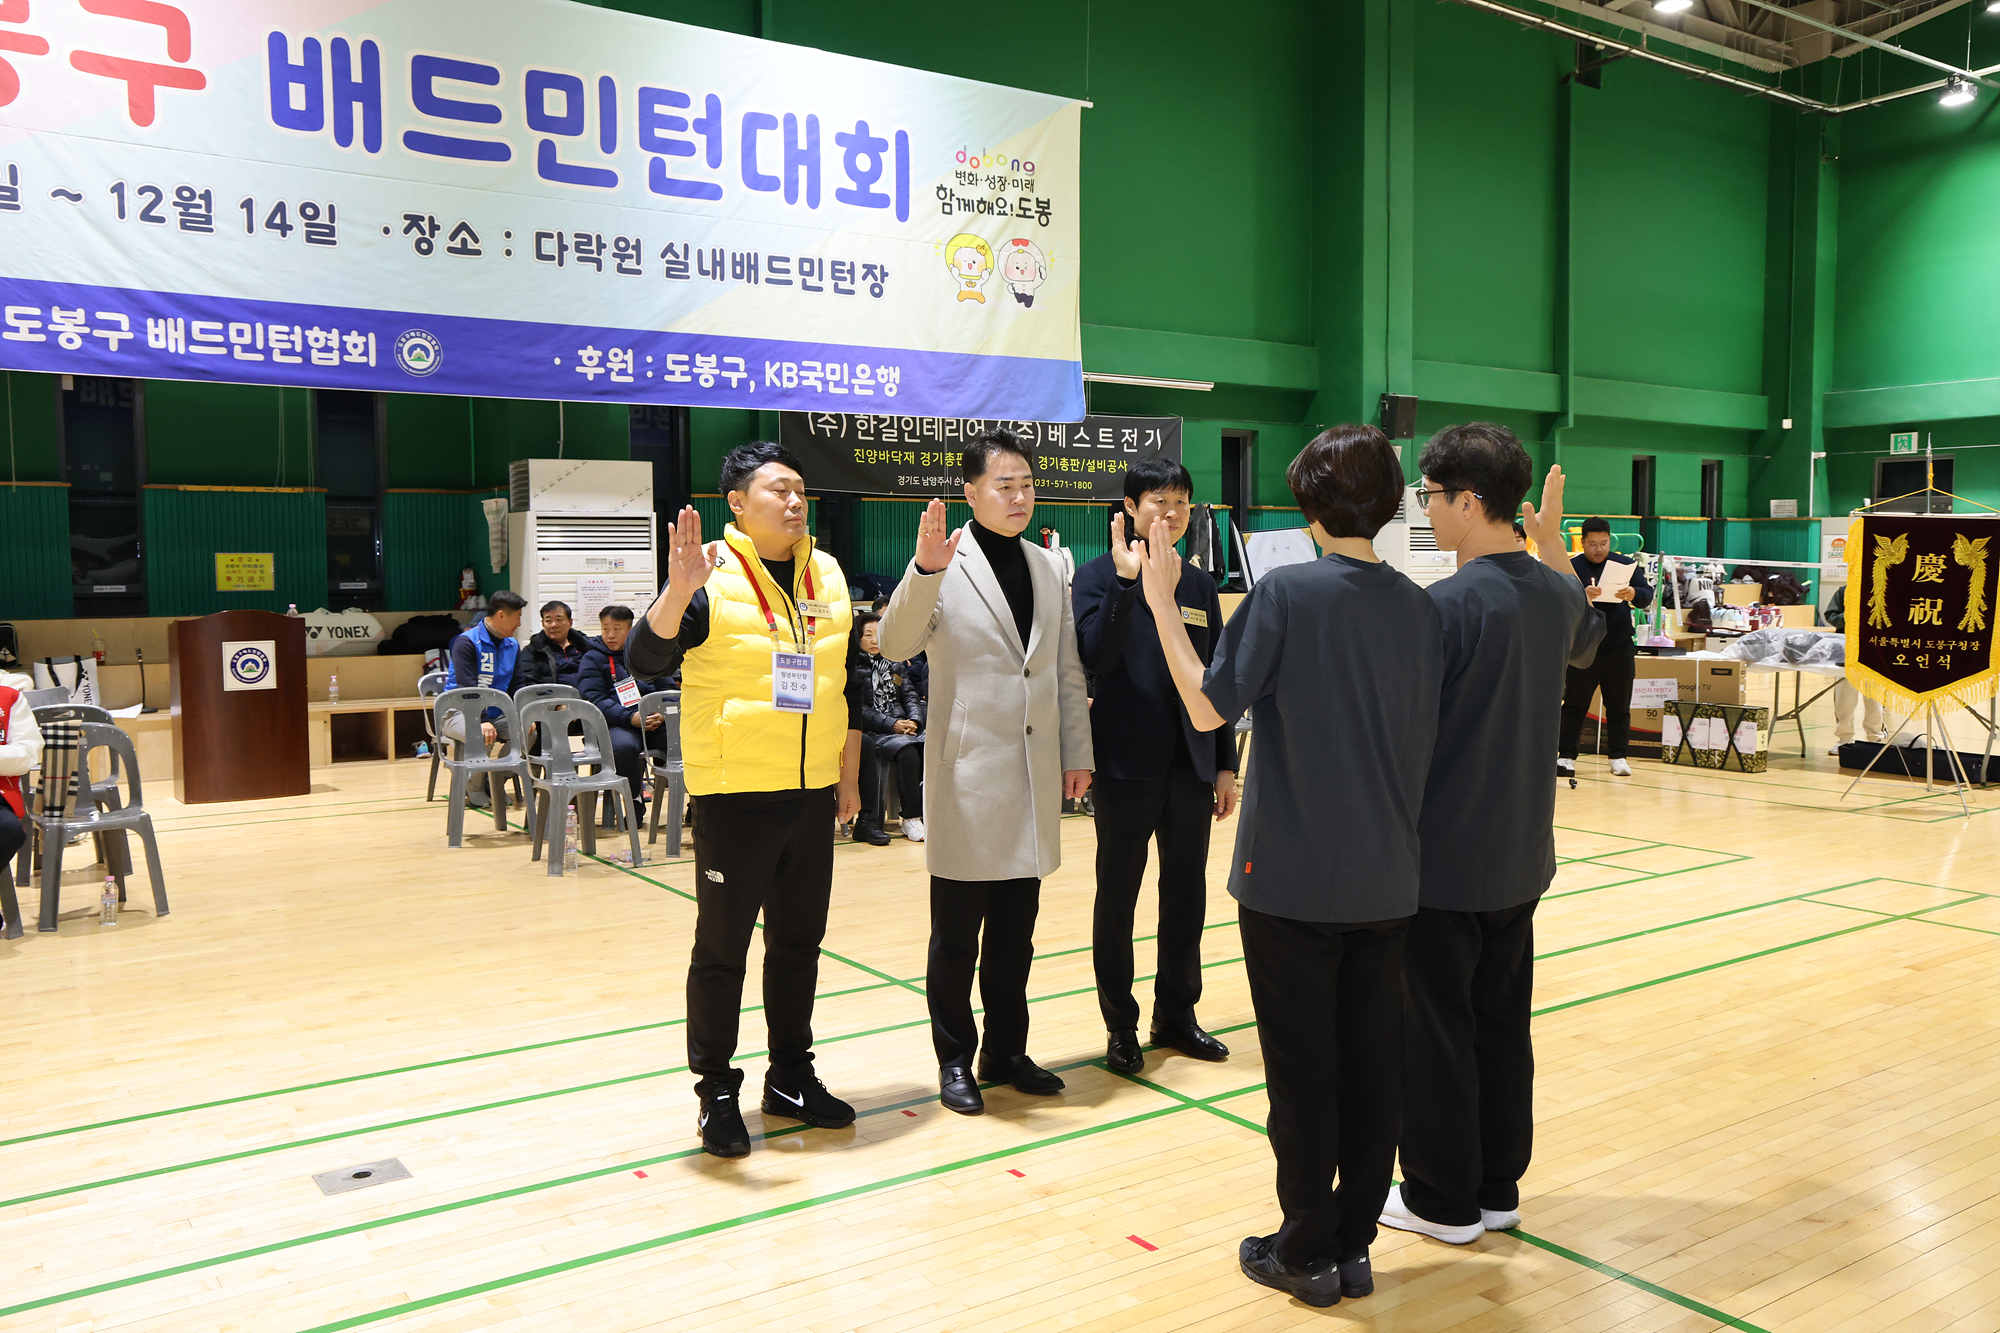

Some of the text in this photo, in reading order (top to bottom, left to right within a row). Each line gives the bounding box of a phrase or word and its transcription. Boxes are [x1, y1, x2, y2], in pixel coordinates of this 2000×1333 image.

[268, 31, 910, 223] 배드민턴대회
[956, 144, 1036, 177] dobong
[109, 181, 215, 235] 12월
[239, 197, 338, 247] 14일
[534, 231, 643, 276] 다락원
[660, 241, 889, 299] 실내배드민턴장
[2, 305, 134, 351] 도봉구
[146, 316, 377, 367] 배드민턴협회
[575, 345, 634, 382] 후원
[765, 360, 900, 397] KB국민은행
[854, 413, 985, 443] 한길인테리어
[854, 448, 915, 465] 진양바닥재
[1038, 455, 1128, 473] 경기총판/설비공사
[898, 475, 920, 486] 경기도
[922, 476, 952, 487] 남양주시
[1034, 479, 1093, 490] 031-571-1800
[327, 625, 370, 639] YONEX
[1868, 635, 1981, 652] 서울특별시 도봉구청장
[780, 657, 808, 667] 도봉구협회
[1891, 653, 1951, 670] 오언석
[781, 681, 807, 691] 김진수
[1677, 682, 1701, 692] oogl
[1702, 683, 1712, 691] TV
[1646, 709, 1658, 718] 50
